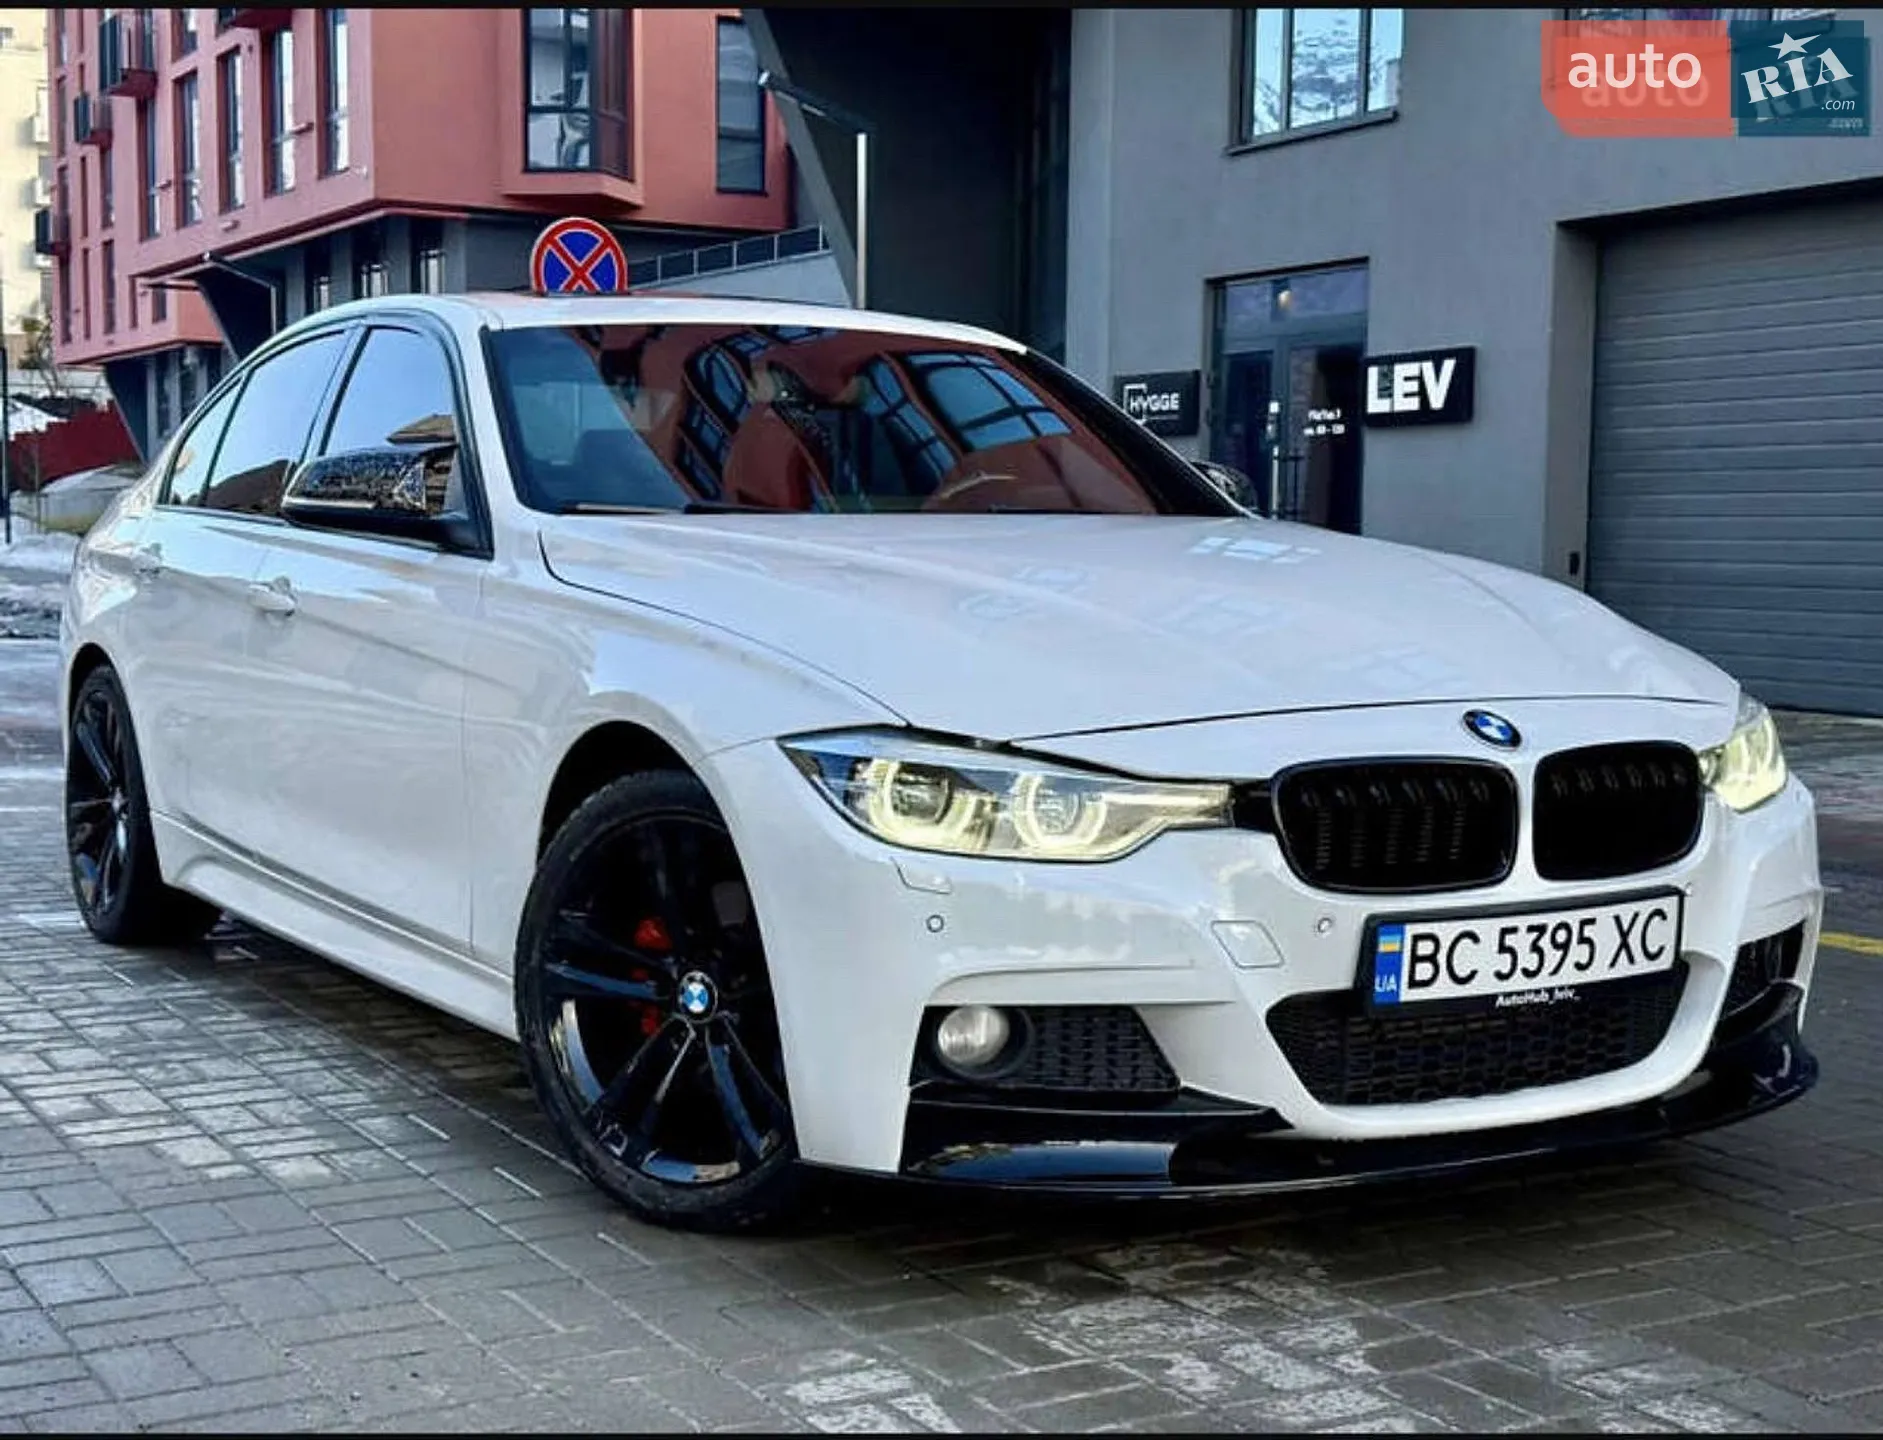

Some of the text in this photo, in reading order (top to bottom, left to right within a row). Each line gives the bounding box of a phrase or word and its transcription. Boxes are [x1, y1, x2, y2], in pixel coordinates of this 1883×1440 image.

[1130, 392, 1180, 412] HYGGE
[1367, 358, 1457, 414] LEV
[1408, 908, 1668, 989] BC 5395 XC
[1374, 973, 1398, 993] UA
